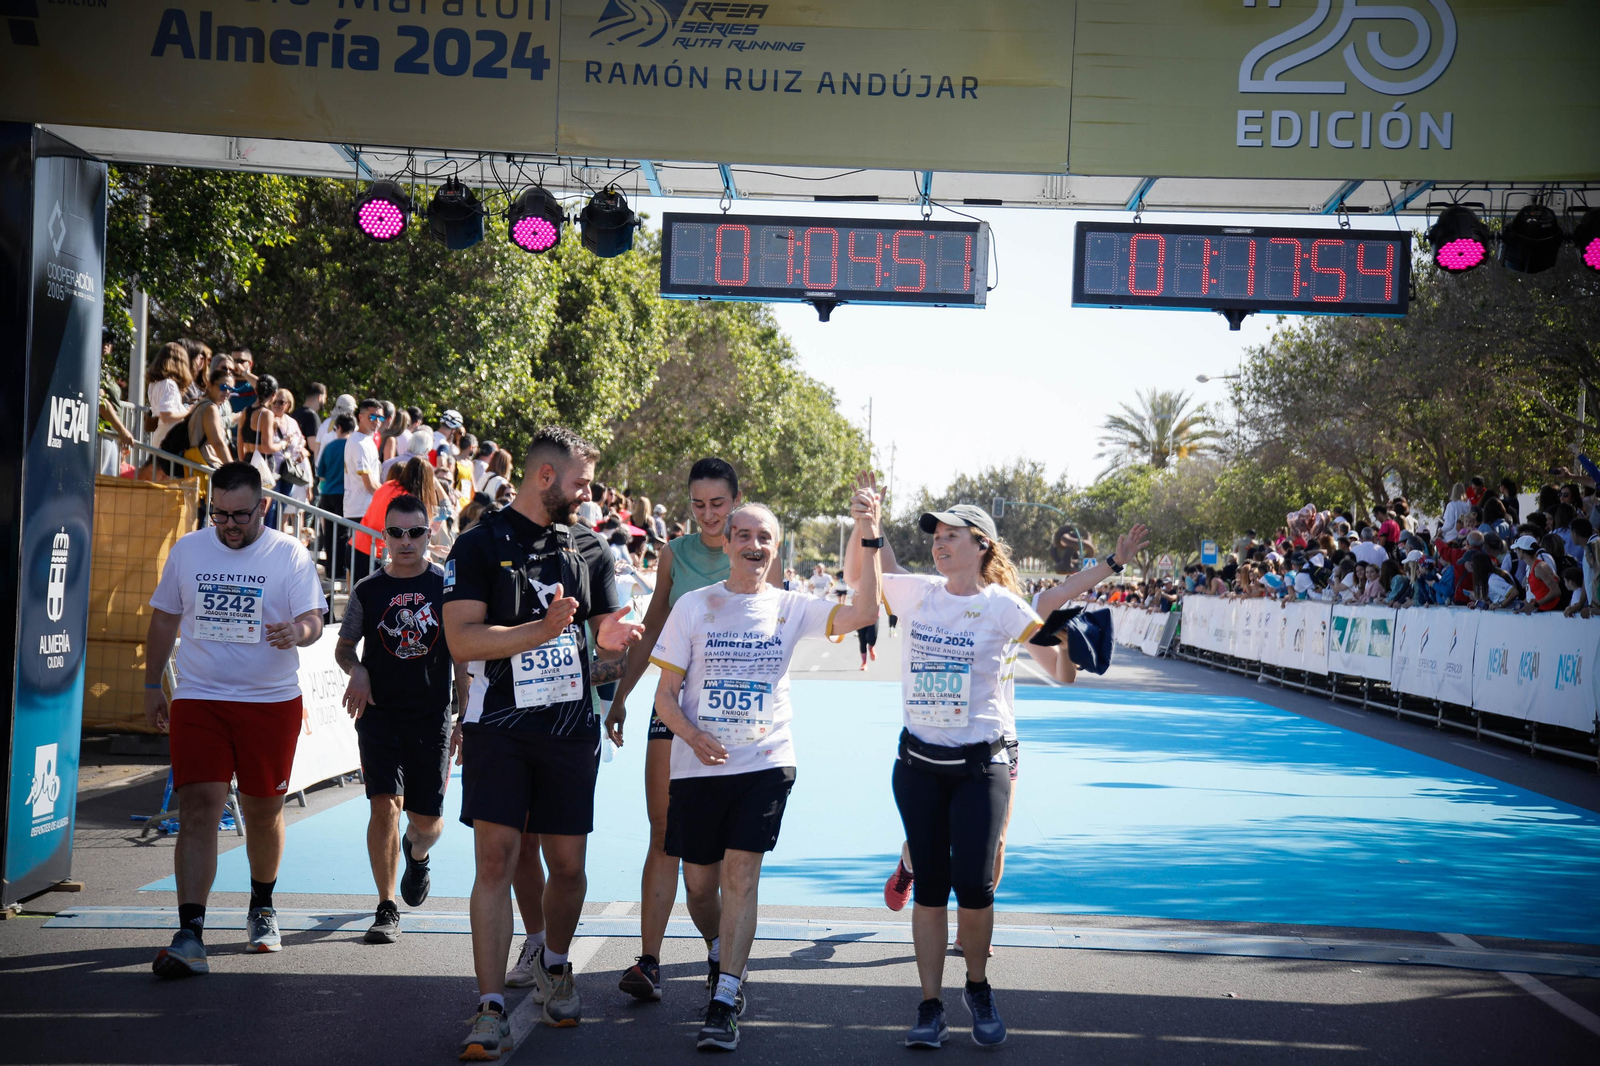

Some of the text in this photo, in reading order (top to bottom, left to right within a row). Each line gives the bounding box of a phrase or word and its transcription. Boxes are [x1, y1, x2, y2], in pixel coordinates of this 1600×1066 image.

[688, 2, 769, 21] RFEA
[680, 21, 760, 38] SERIES
[150, 8, 551, 81] Almería 2024
[672, 37, 806, 53] RUTA RUNNING
[585, 59, 979, 100] RAMÓN RUIZ ANDÚJAR
[1236, 101, 1454, 150] EDICIÓN
[1128, 232, 1395, 303] 01:17:54
[47, 280, 65, 301] 2005
[195, 573, 266, 584] COSENTINO
[203, 593, 255, 613] 5242
[389, 592, 426, 607] AFP
[707, 631, 739, 639] Medio
[911, 620, 933, 632] Medio
[39, 629, 70, 654] ALMERÍA
[705, 639, 752, 649] Almería
[910, 628, 975, 647] Almería 2024
[521, 647, 574, 672] 5388
[926, 645, 941, 653] RUIZ
[943, 648, 975, 656] ANDÚJAR
[47, 656, 64, 669] CIUDAD
[914, 672, 963, 693] 5050
[707, 690, 763, 712] 5051
